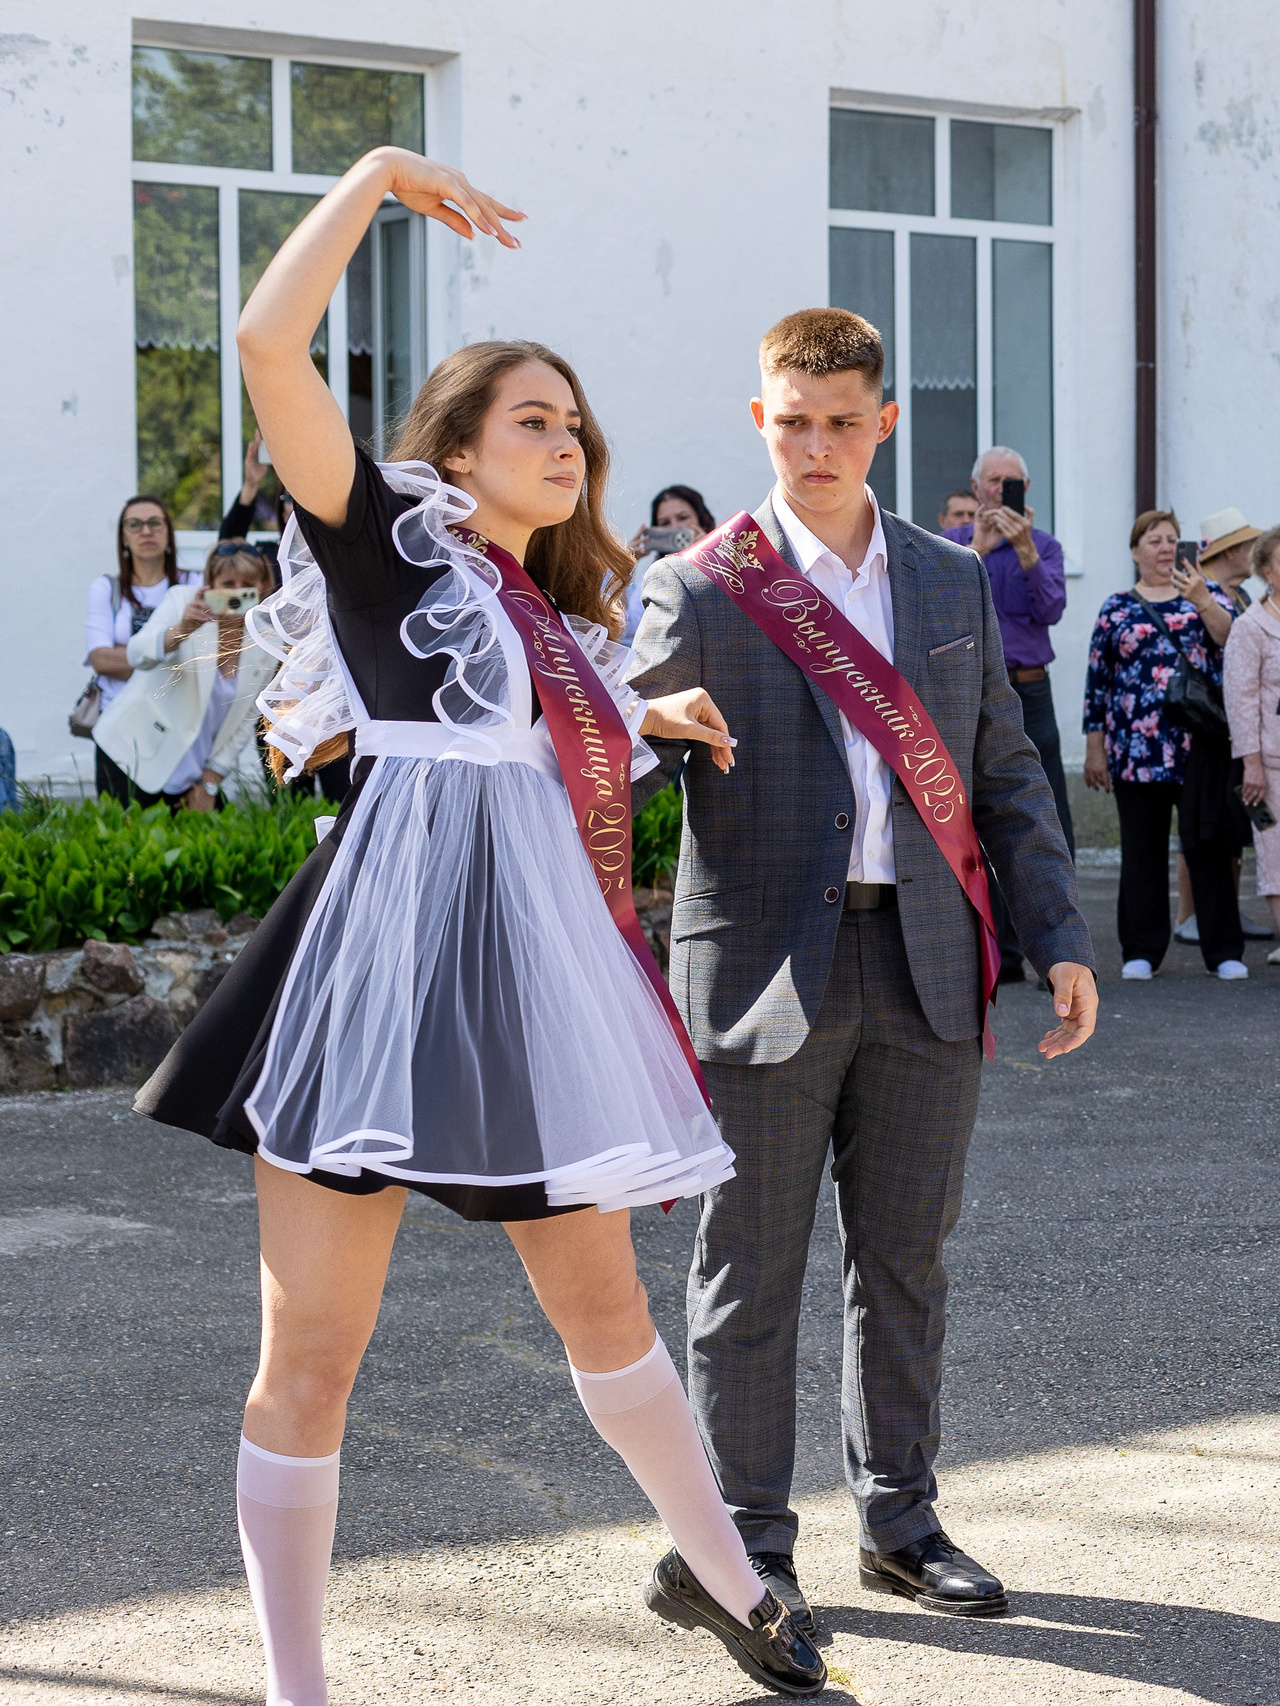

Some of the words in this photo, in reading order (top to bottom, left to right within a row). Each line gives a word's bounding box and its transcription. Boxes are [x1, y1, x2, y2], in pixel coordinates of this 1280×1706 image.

[761, 579, 915, 742] Выпускник
[899, 737, 965, 823] 2025
[588, 803, 627, 896] 2025
